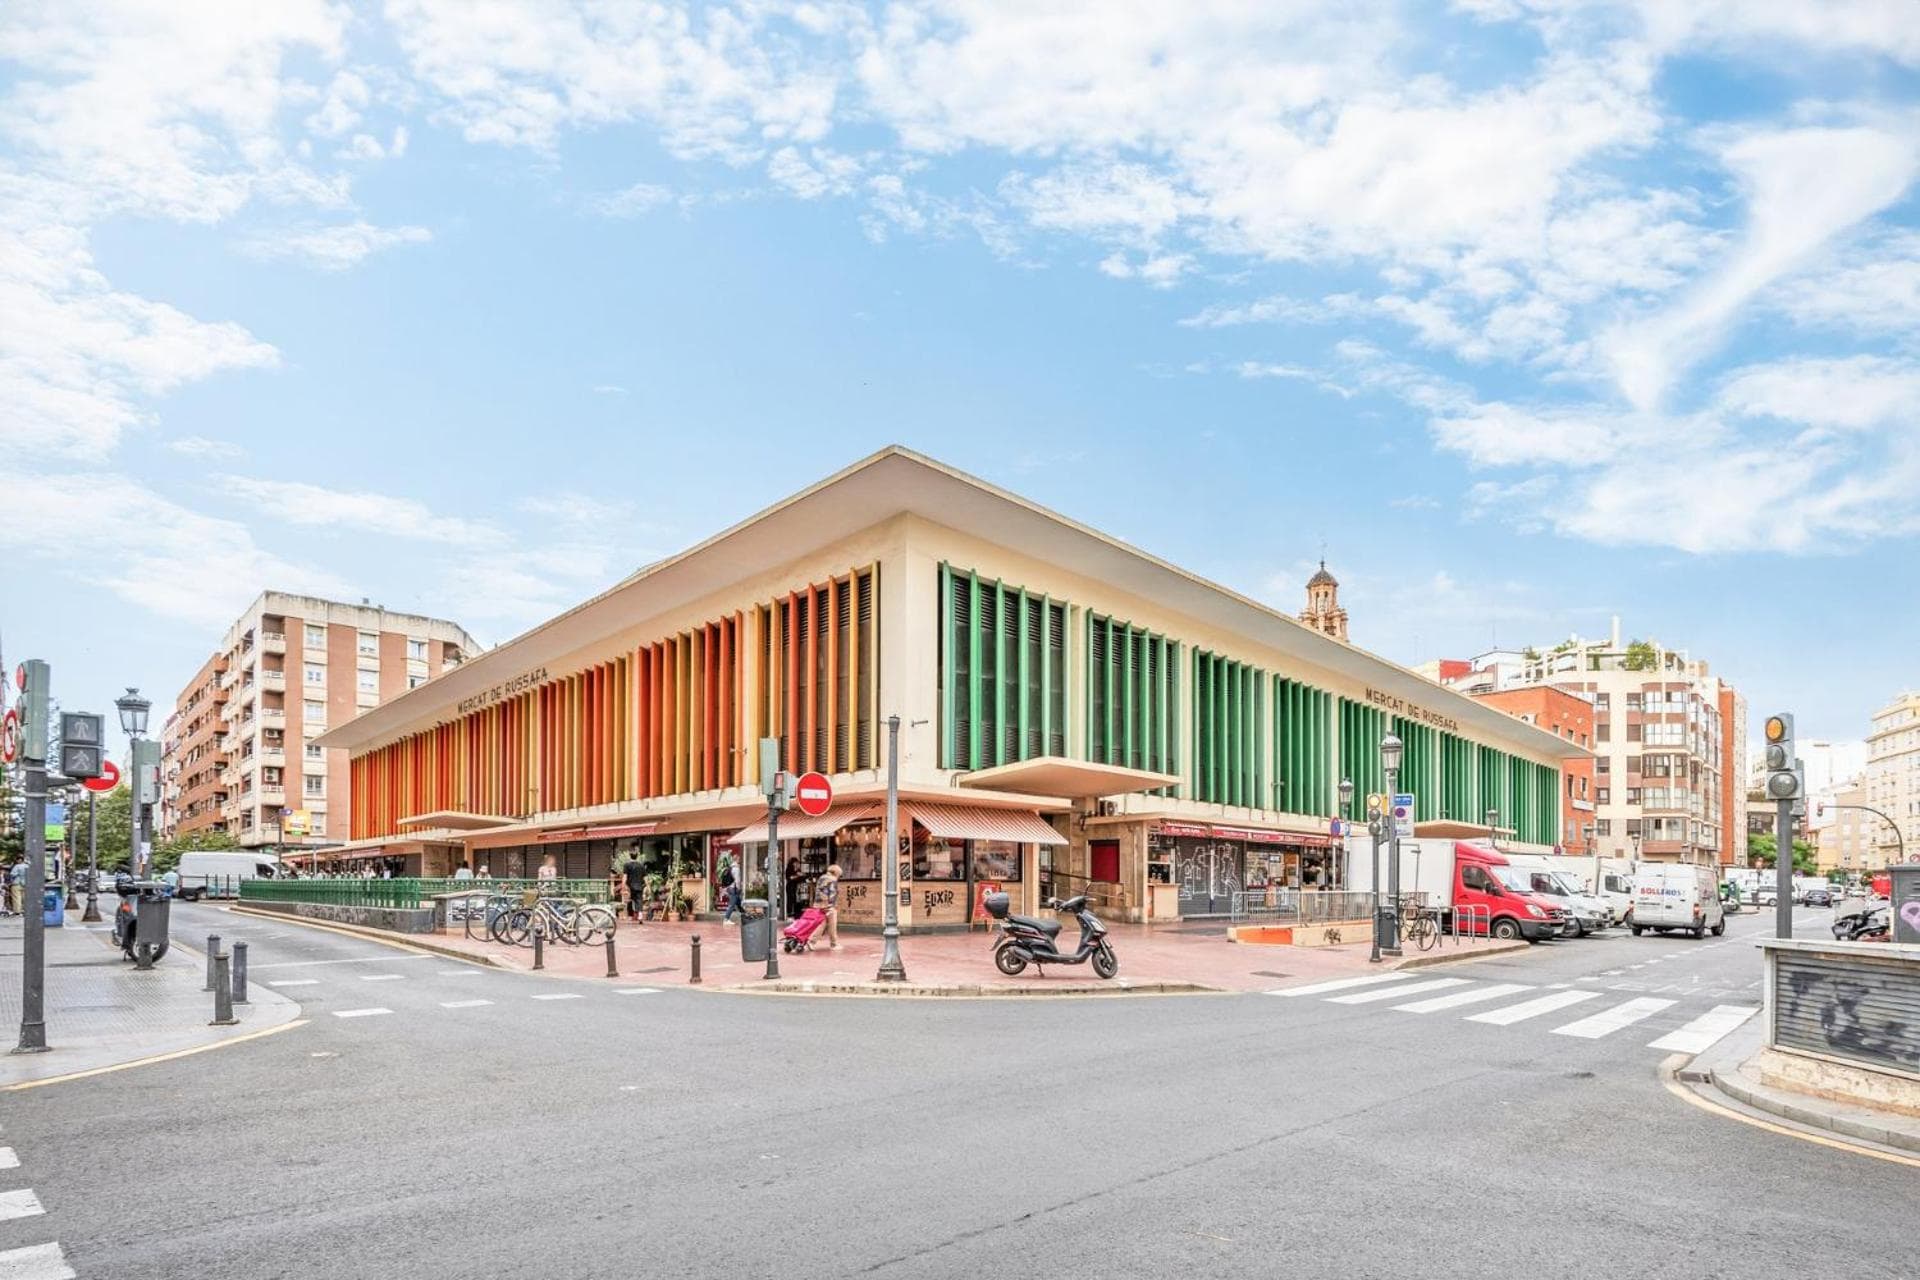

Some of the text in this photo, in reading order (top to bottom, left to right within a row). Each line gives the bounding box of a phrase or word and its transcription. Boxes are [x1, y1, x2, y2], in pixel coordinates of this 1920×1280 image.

[457, 667, 548, 714] MERCAT DE RUSSAFA
[1365, 687, 1459, 731] MERCAT DE RUSSAFA
